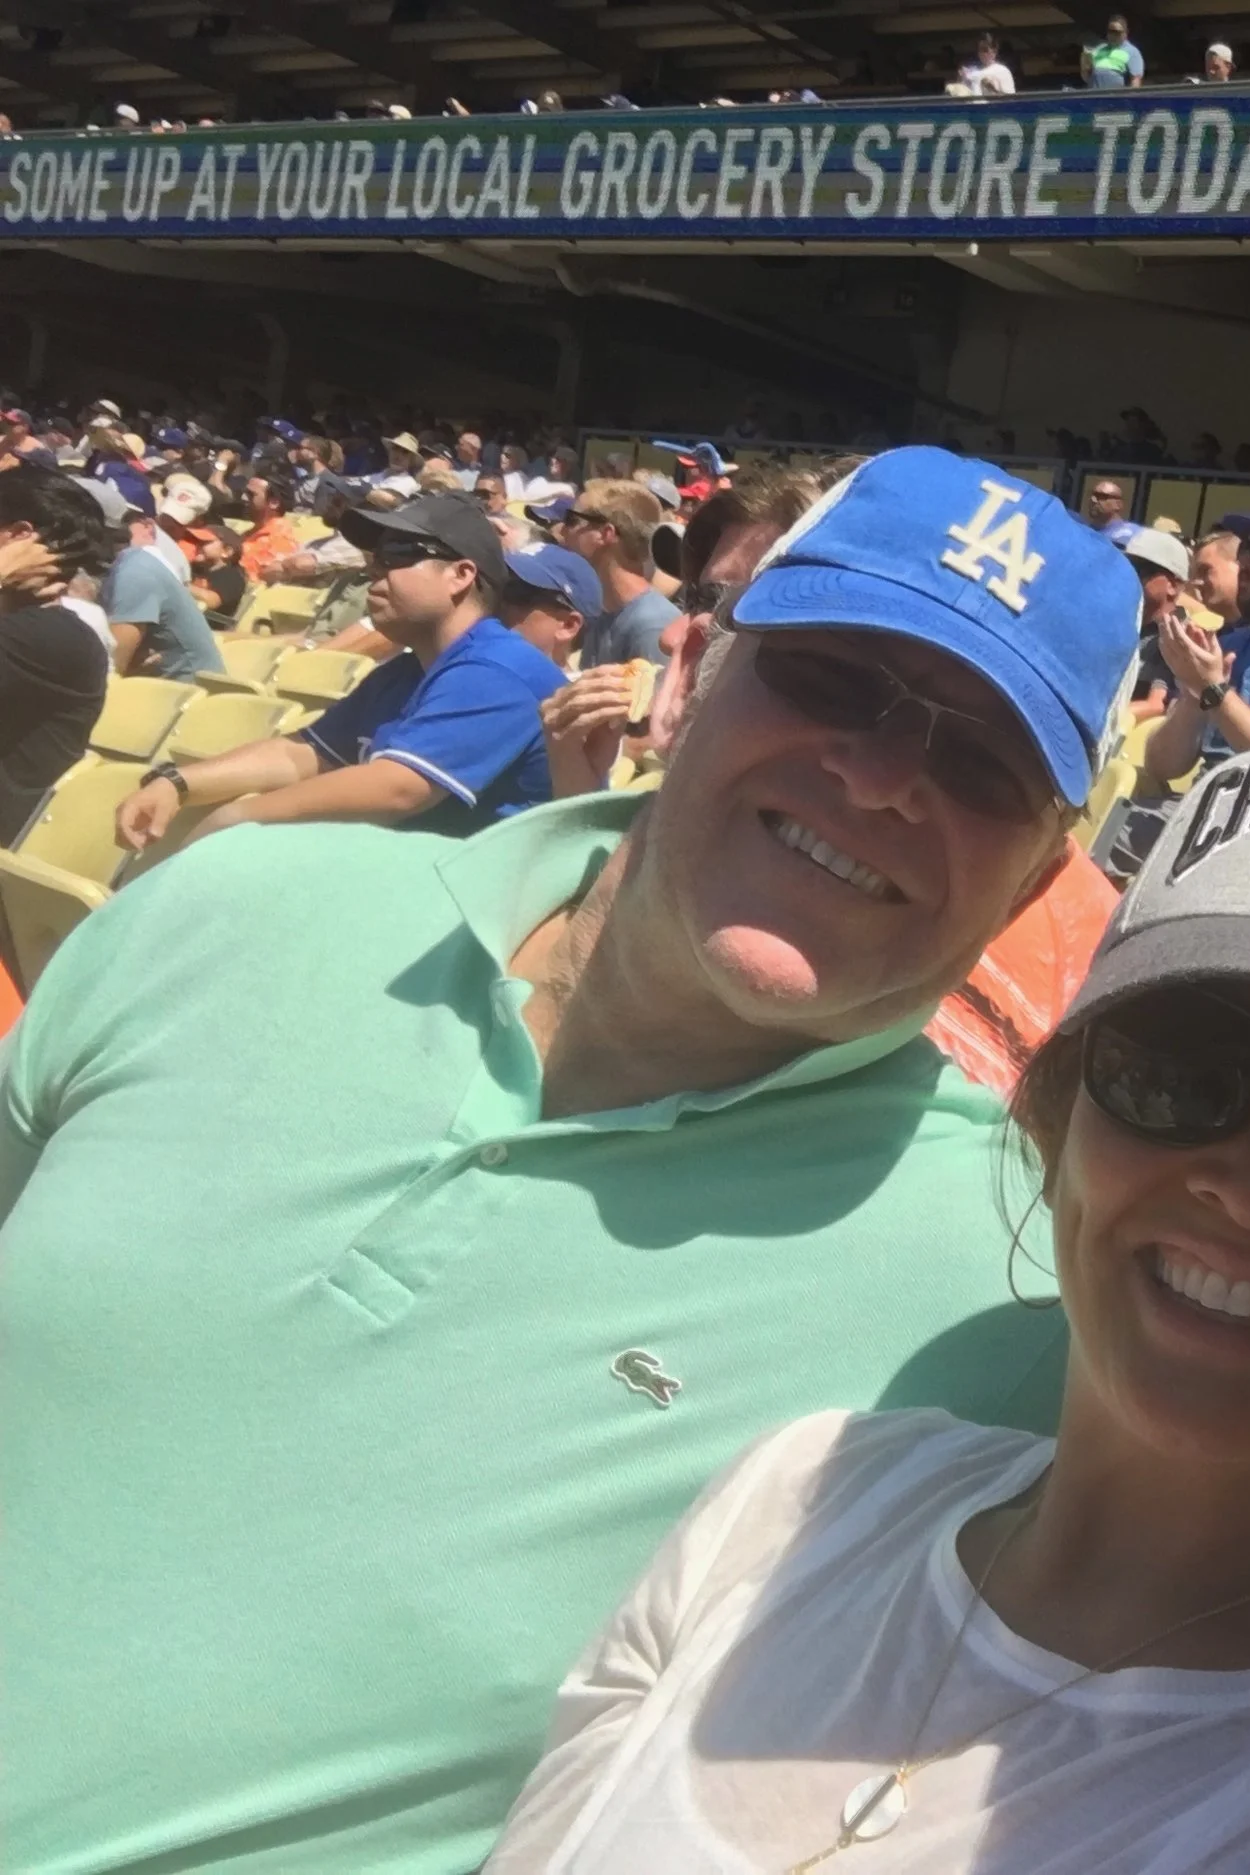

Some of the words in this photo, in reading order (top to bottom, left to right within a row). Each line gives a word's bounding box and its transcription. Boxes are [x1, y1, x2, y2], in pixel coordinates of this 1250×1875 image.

[4, 150, 117, 223] SOME
[123, 146, 182, 222] UP
[185, 143, 248, 222] AT
[256, 139, 375, 221] YOUR
[385, 133, 541, 220] LOCAL
[560, 124, 836, 220] GROCERY
[845, 115, 1071, 220] STORE
[940, 479, 1046, 612] LA
